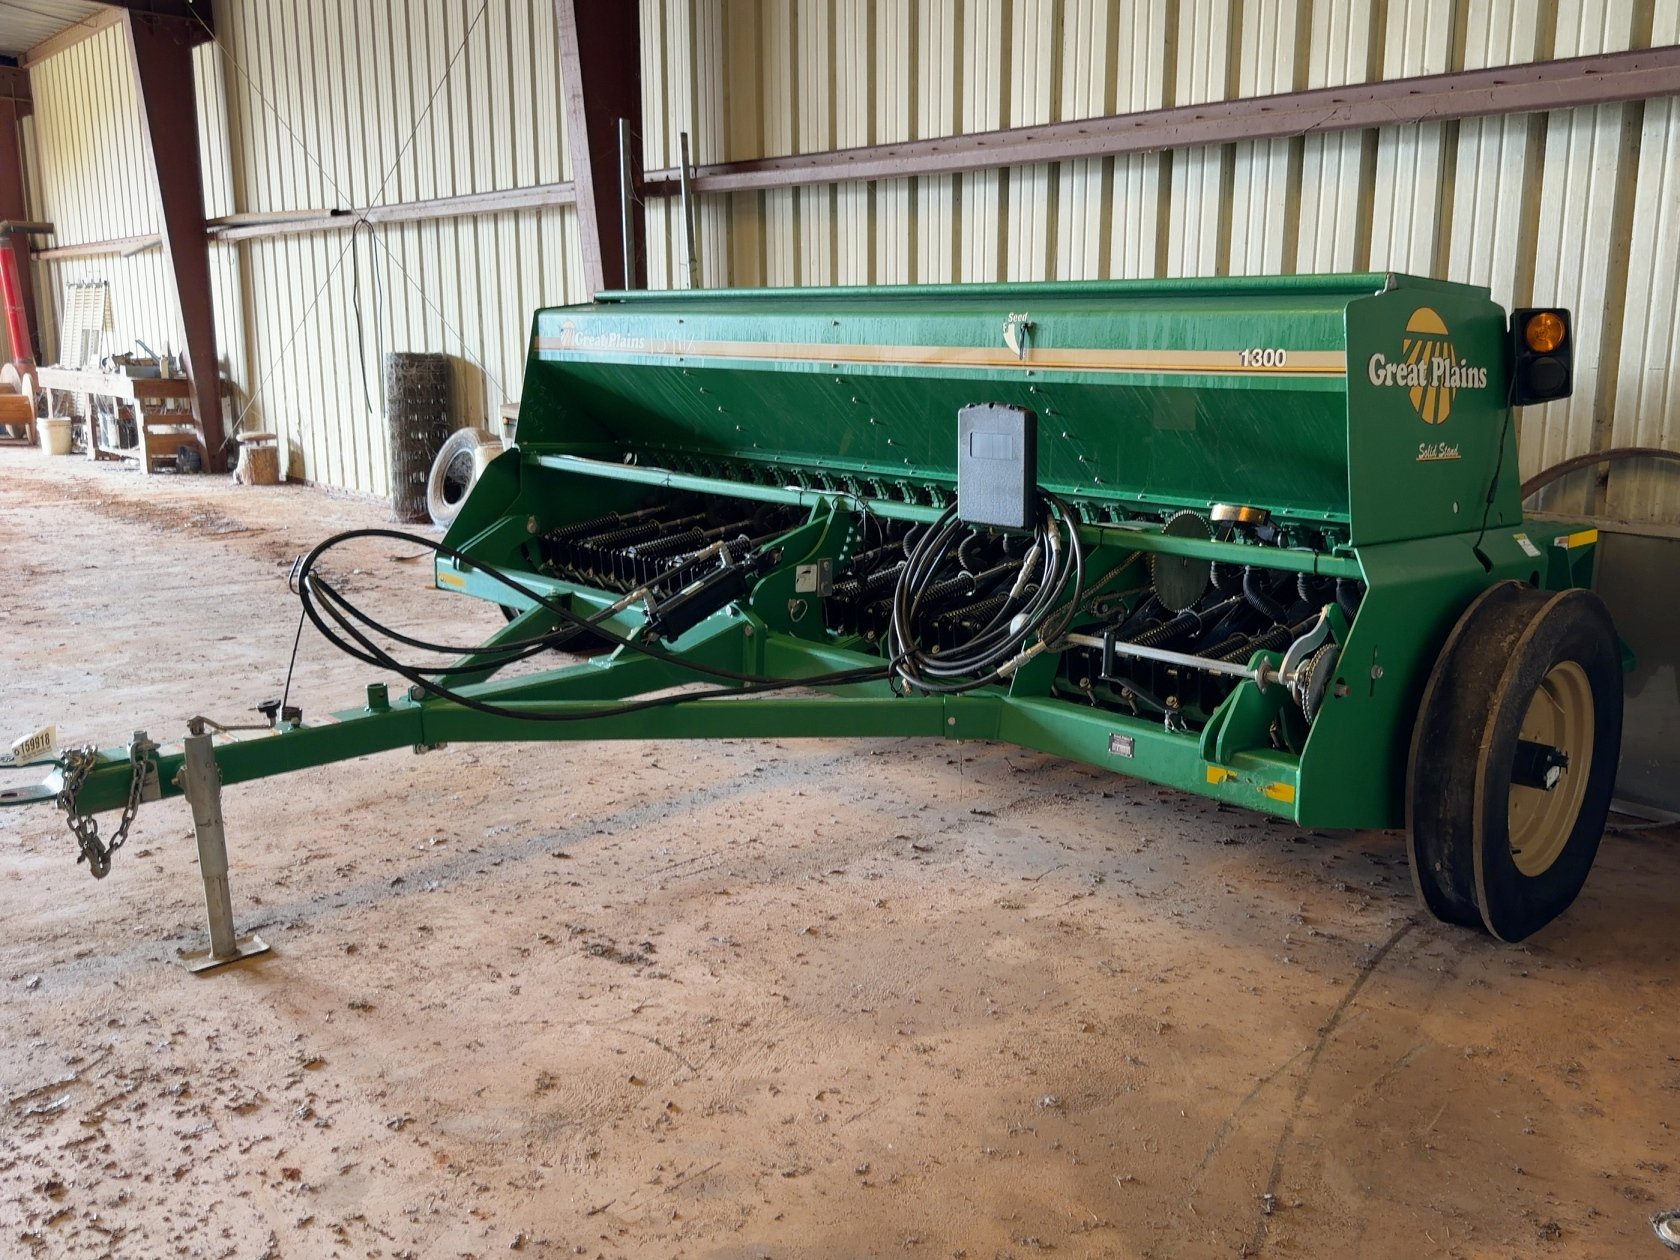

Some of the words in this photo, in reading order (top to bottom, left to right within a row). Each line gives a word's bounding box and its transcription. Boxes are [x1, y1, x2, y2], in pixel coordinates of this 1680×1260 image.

[1008, 312, 1028, 322] Seed
[574, 331, 608, 348] Great
[609, 332, 645, 349] Plains
[1239, 347, 1287, 367] 1300
[1368, 352, 1428, 386] Great
[1431, 357, 1488, 388] Plains
[1418, 443, 1438, 458] Solid
[1439, 442, 1459, 457] Stand
[20, 732, 50, 755] 159918
